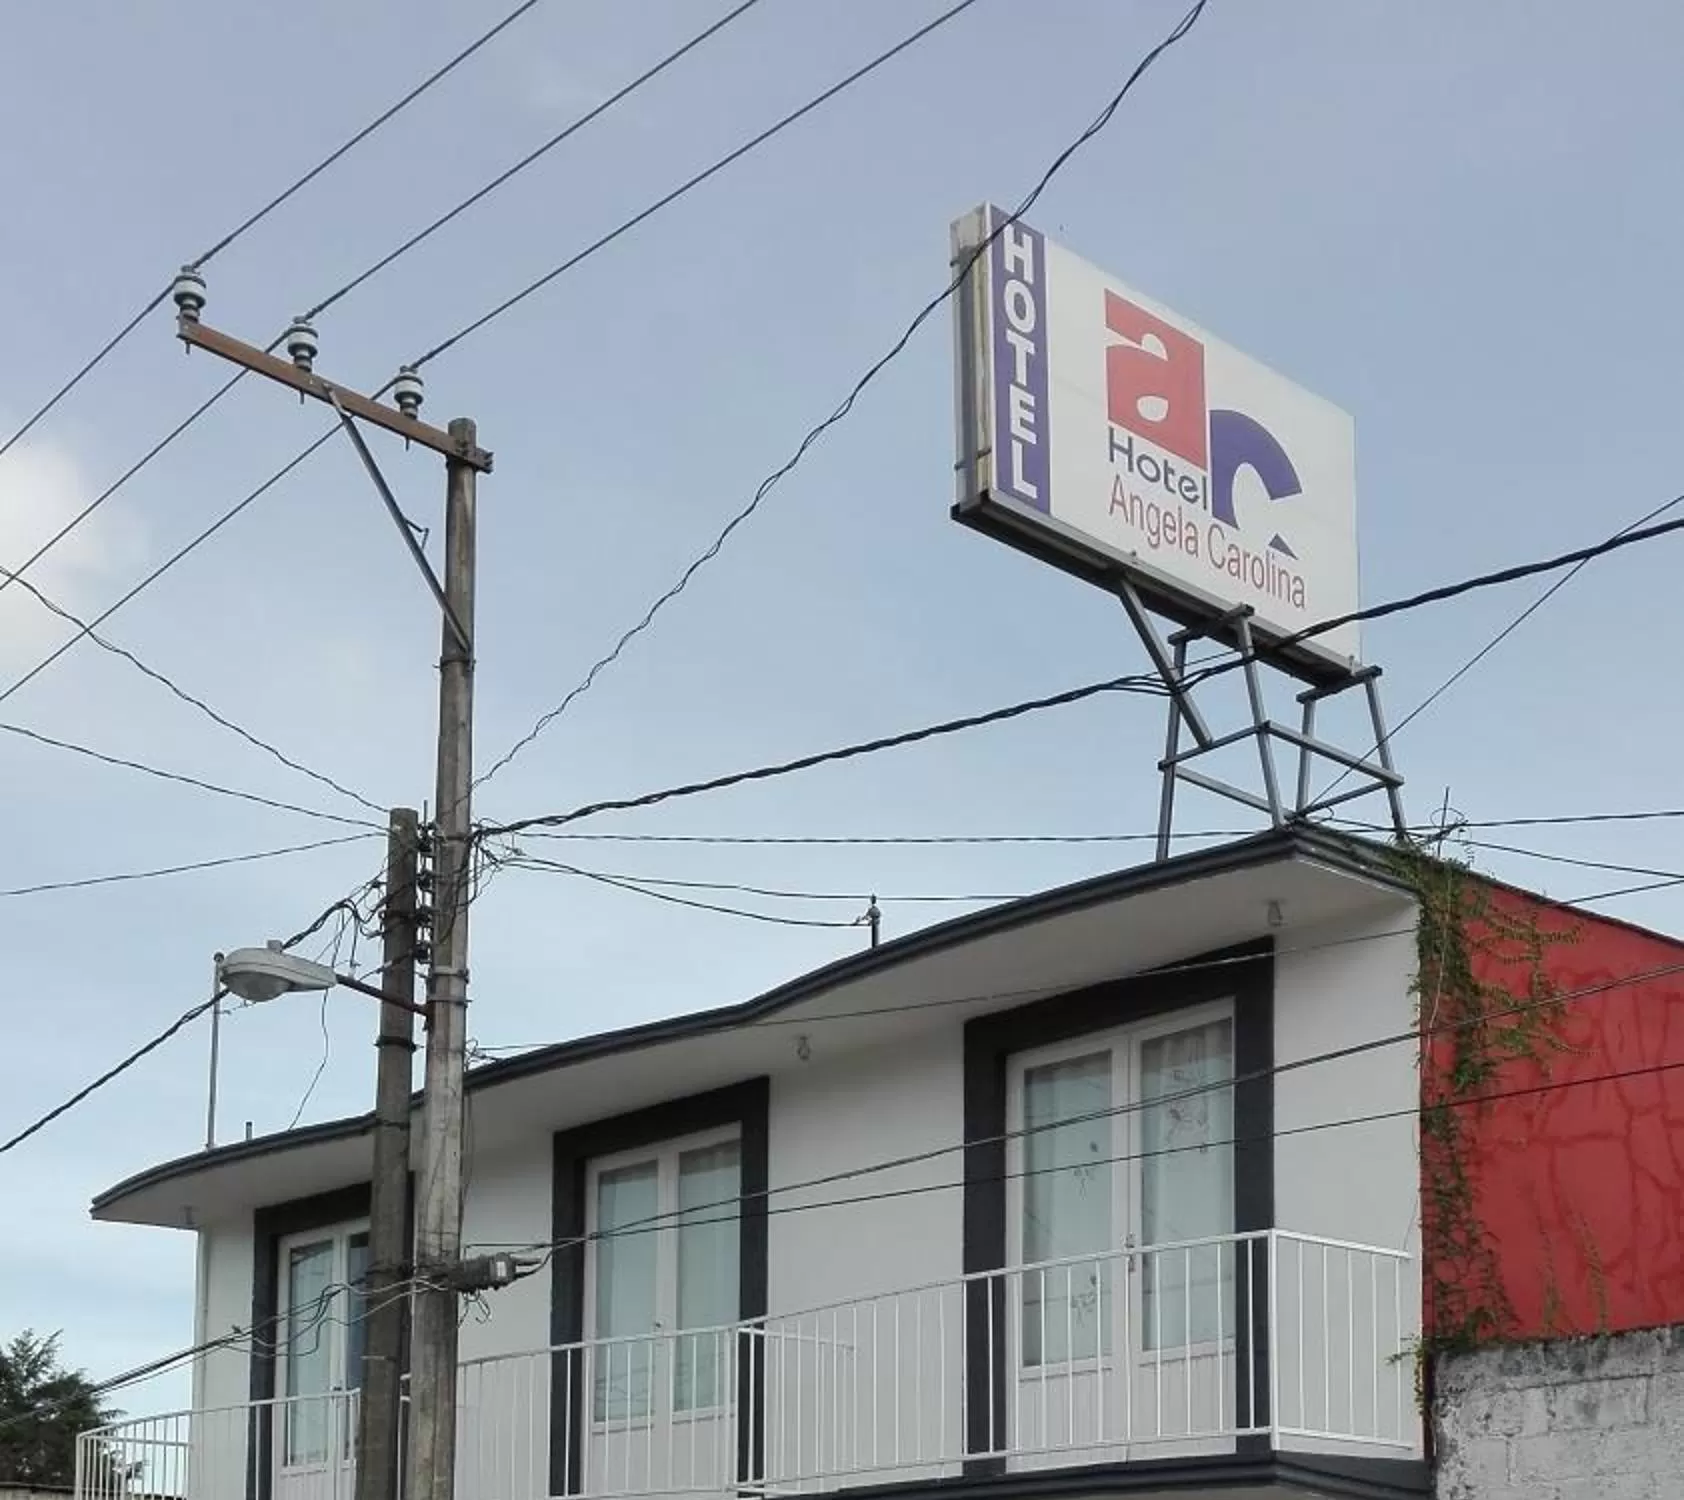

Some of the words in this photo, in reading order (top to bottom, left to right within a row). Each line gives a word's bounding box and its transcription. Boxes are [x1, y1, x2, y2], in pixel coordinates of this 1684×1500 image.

[1004, 222, 1038, 499] HOTEL
[1108, 424, 1208, 511] Hotel
[1108, 473, 1200, 558] Angela
[1207, 522, 1306, 609] Carolina
